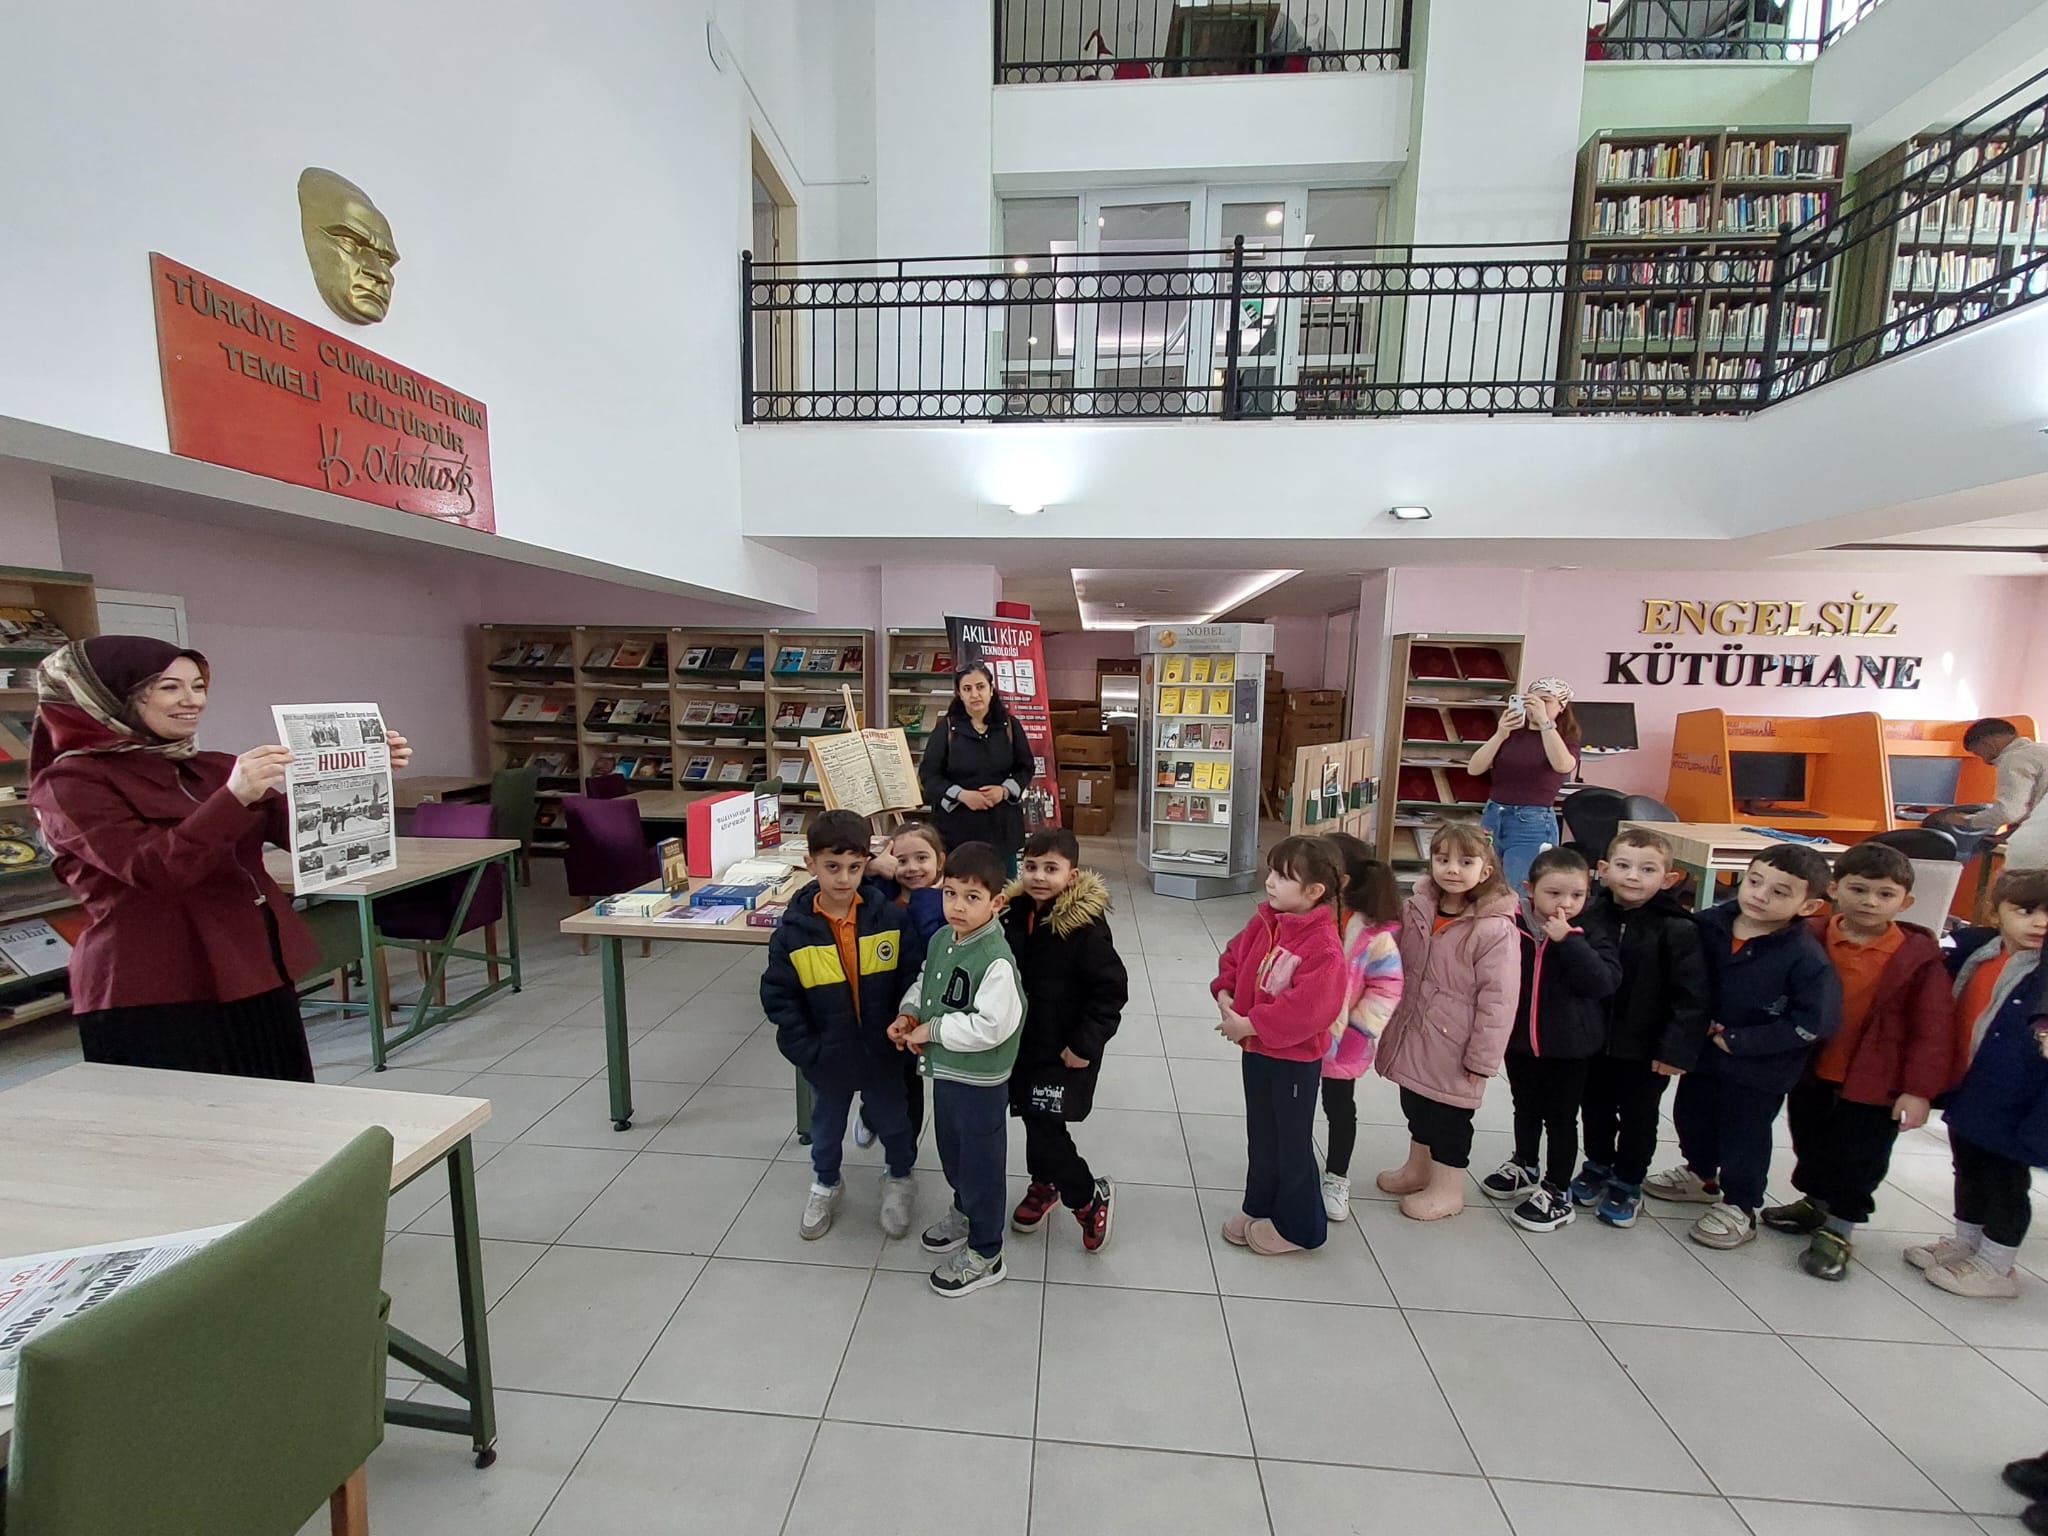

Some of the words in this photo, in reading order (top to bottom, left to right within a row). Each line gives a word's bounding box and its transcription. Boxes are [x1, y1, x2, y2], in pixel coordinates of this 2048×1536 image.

[166, 272, 298, 352] TÜRKİYE
[317, 340, 484, 431] CUMHURİYETİNİN
[219, 341, 321, 402] TEMELİ
[348, 390, 465, 455] KÜLTÜRDÜR
[962, 624, 998, 645] AKILLI
[1000, 626, 1033, 647] KİTAP
[1186, 626, 1225, 637] NOBEL
[1638, 590, 1900, 638] ENGELSİZ
[1602, 642, 1923, 690] KÜTÜPHANE
[318, 750, 367, 772] HUDUT
[941, 966, 972, 1010] D
